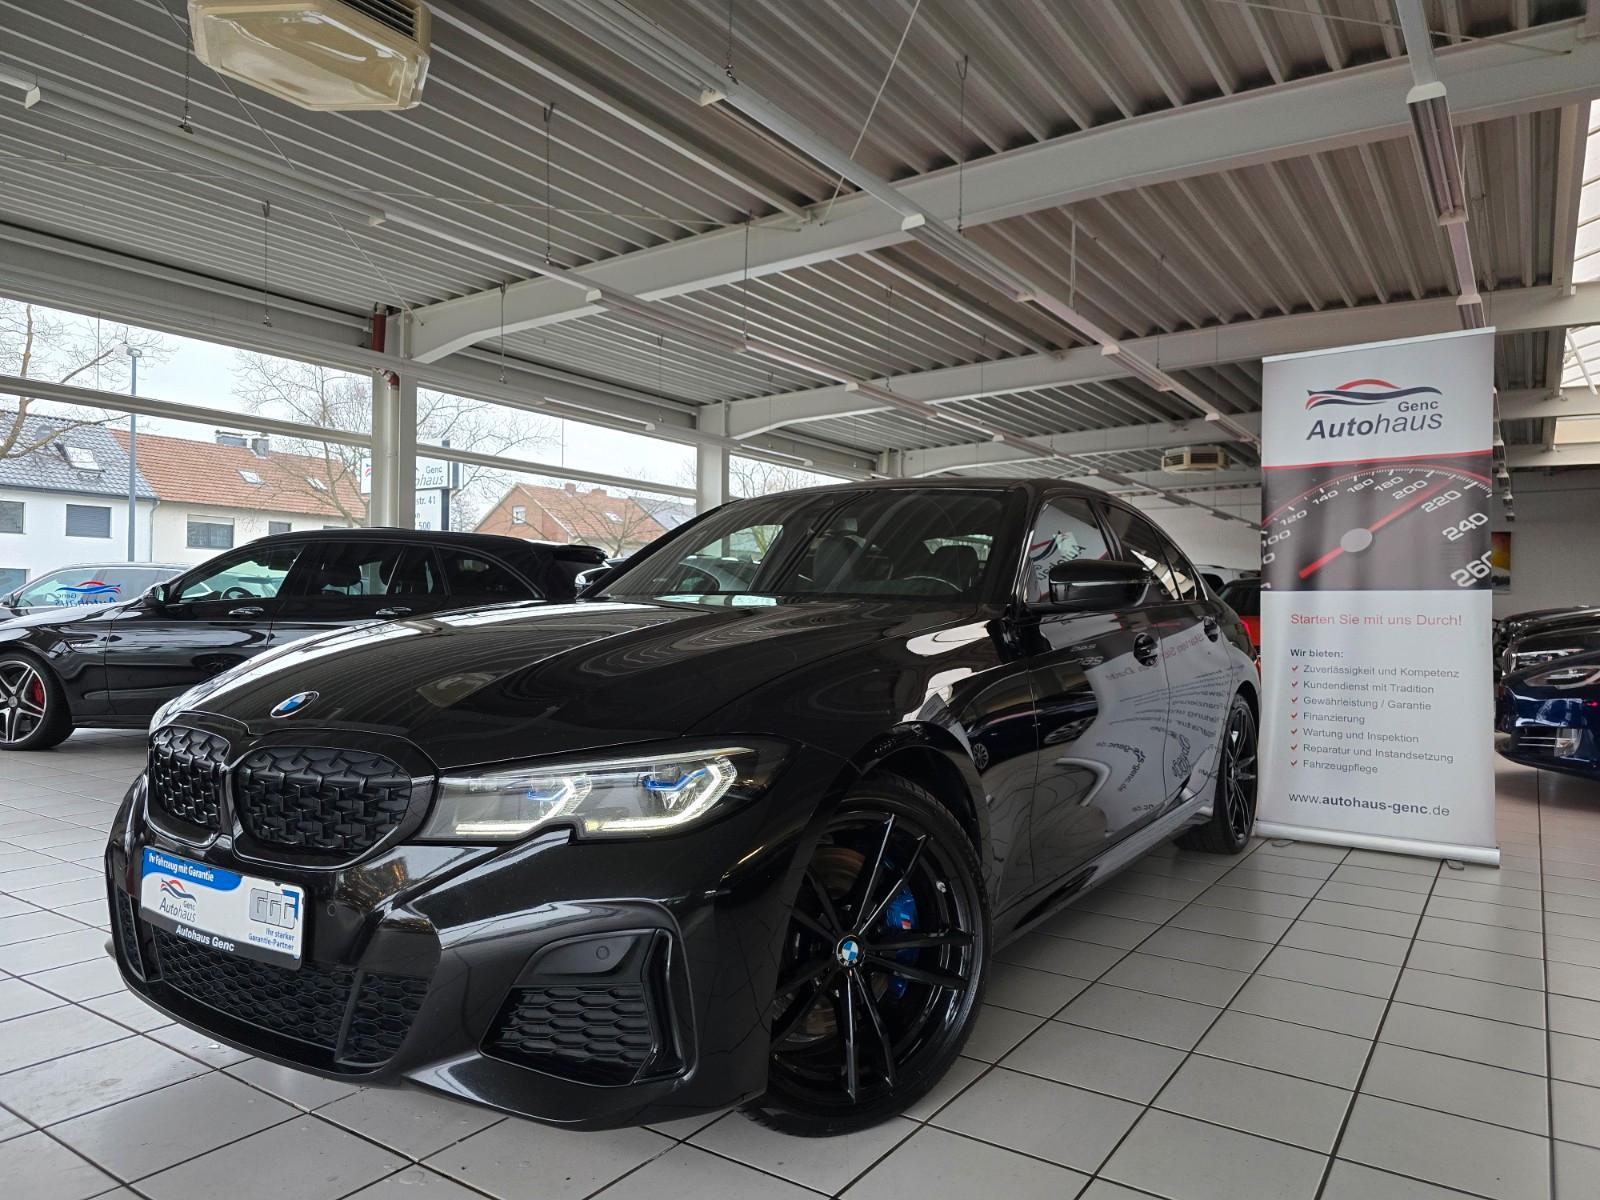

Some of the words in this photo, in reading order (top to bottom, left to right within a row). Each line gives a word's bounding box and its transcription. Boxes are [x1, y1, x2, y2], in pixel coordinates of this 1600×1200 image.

[1398, 401, 1439, 413] Genc
[1306, 413, 1443, 440] Autohaus
[425, 465, 443, 474] Genc
[1374, 476, 1404, 492] 180
[1392, 480, 1427, 500] 200
[428, 496, 436, 505] 41
[1312, 490, 1338, 505] 140
[1421, 490, 1462, 513] 220
[1280, 509, 1307, 526] 120
[1441, 512, 1489, 542] 240
[1262, 529, 1291, 547] 100
[1290, 613, 1335, 625] Starten
[1339, 614, 1360, 625] Sie
[1364, 614, 1383, 625] mit
[1388, 616, 1412, 625] uns
[1416, 614, 1462, 626] Durch!
[1290, 649, 1306, 657] Wir
[1309, 649, 1344, 659] bieten:
[1303, 664, 1375, 676] Zuverlässigkeit
[1378, 667, 1397, 676] und
[1400, 667, 1460, 679] Kompetenz
[1303, 680, 1369, 692] Kundendienst
[1372, 683, 1387, 692] mit
[1388, 683, 1434, 694] Tradition
[1303, 696, 1378, 710] Gewährleistung
[1387, 700, 1432, 711] Garantie
[1303, 712, 1366, 726] Finanzierung
[1303, 727, 1343, 741] Wartung
[1345, 732, 1364, 740] und
[1367, 732, 1419, 743] Inspektion
[1303, 743, 1351, 755] Reparatur
[1353, 748, 1372, 757] und
[1375, 748, 1454, 764] Instandsetzung
[1303, 760, 1378, 775] Fahrzeugpflege
[1288, 792, 1450, 816] www.autohaus-genc.de
[148, 852, 156, 863] Ihr
[156, 856, 179, 874] Fahrzeug
[180, 863, 188, 875] mit
[189, 866, 215, 882] Garantie
[160, 897, 197, 923] Autohaus
[183, 900, 196, 911] Genc
[176, 924, 211, 945] Autohaus
[212, 936, 235, 952] Genc
[249, 932, 294, 951] Garantie-Partner
[265, 928, 274, 936] Ihr
[275, 930, 295, 942] starker
